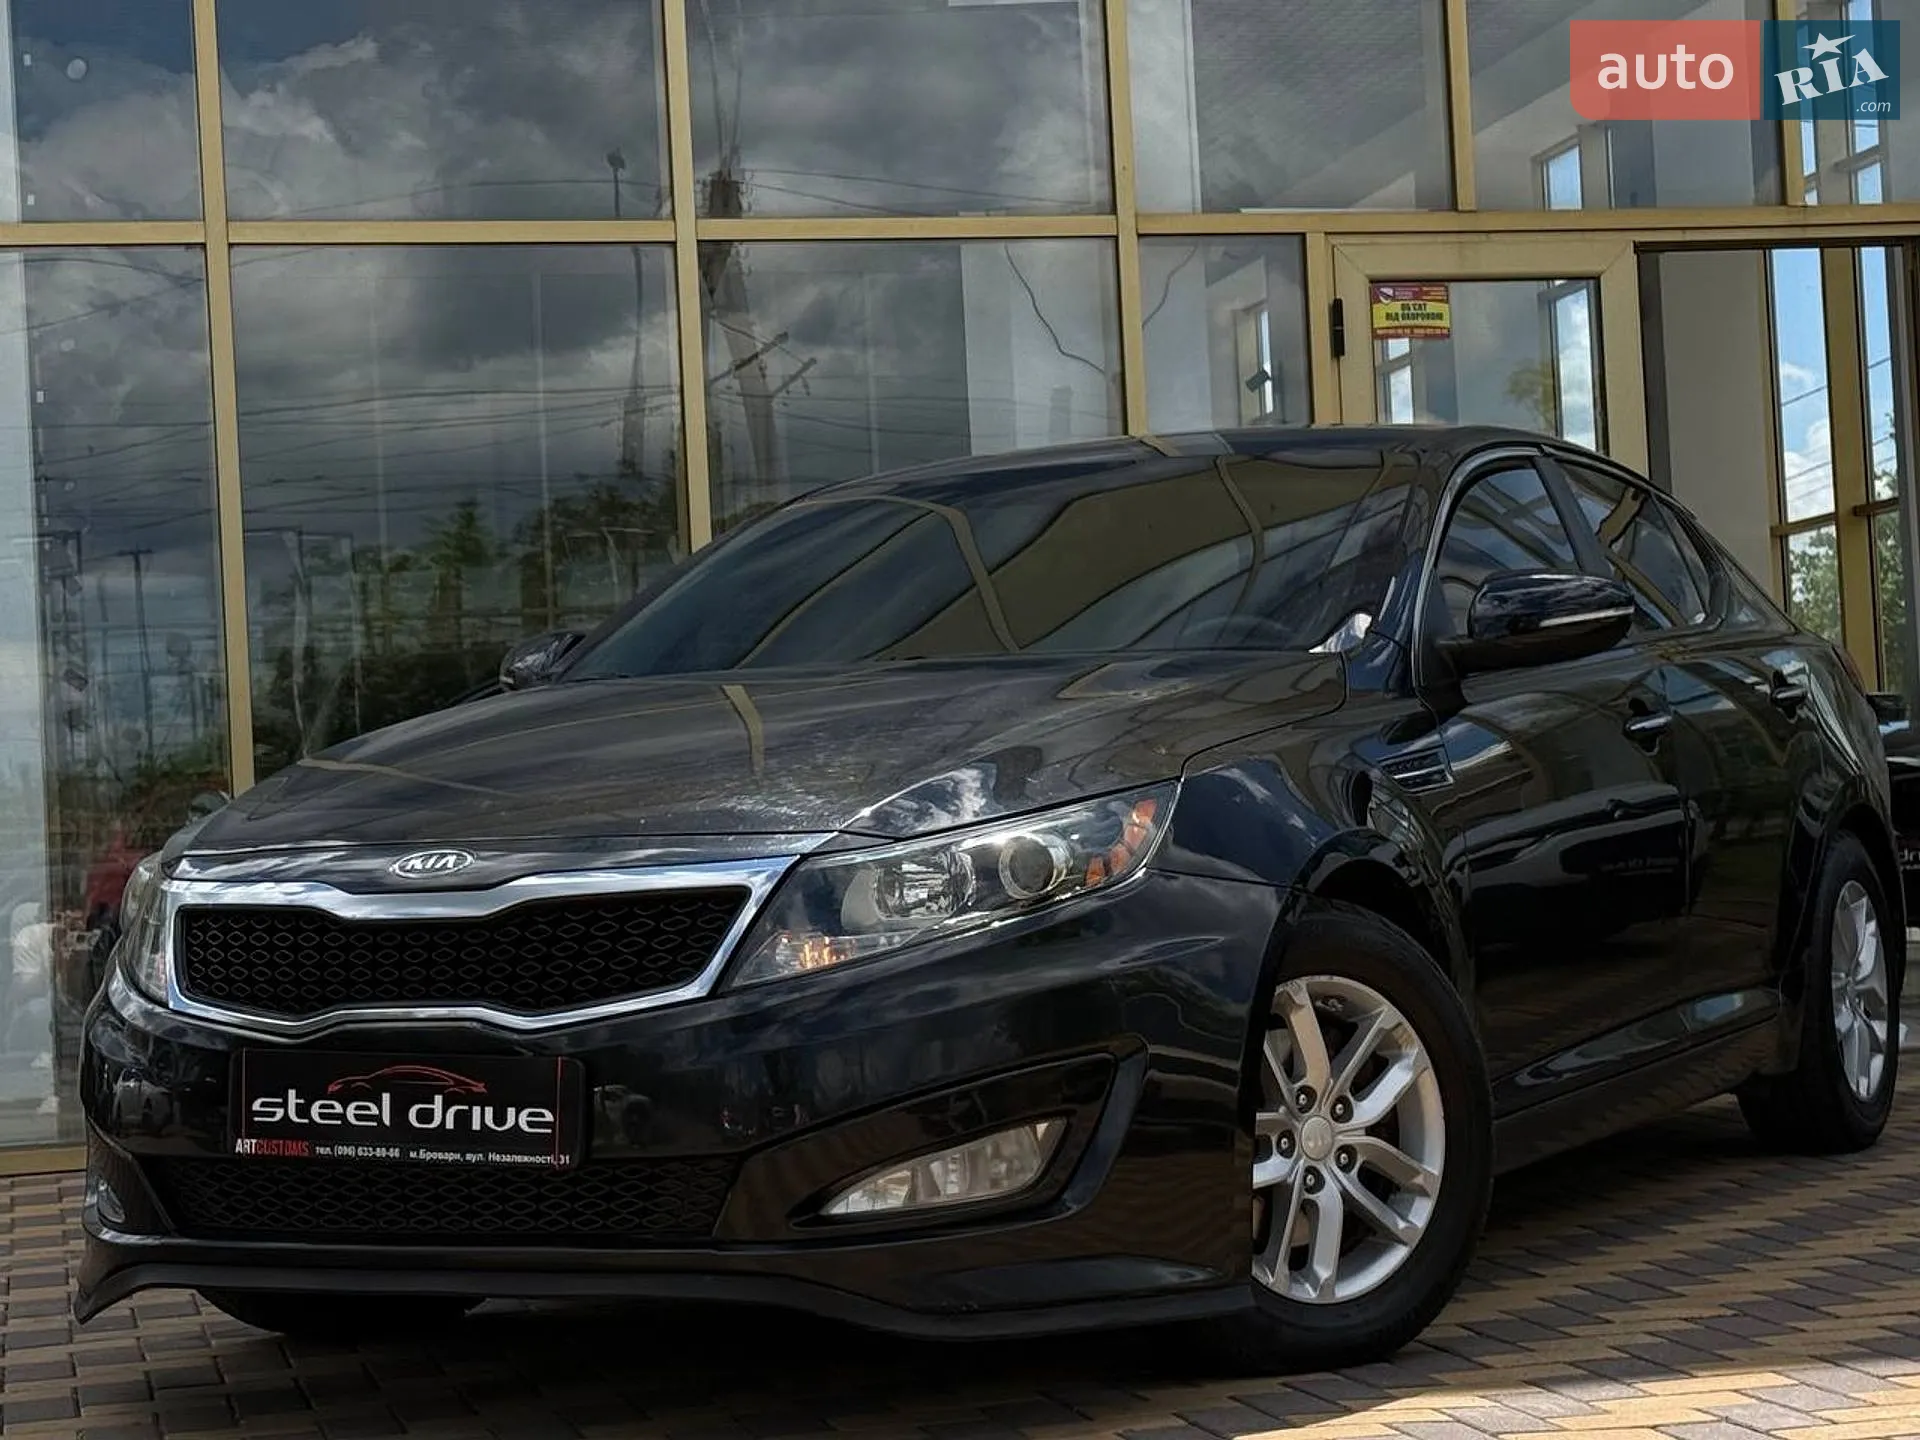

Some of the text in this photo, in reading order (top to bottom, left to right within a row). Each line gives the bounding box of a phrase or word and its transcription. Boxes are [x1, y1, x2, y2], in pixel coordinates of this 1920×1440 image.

[403, 854, 459, 871] KIA
[252, 1088, 555, 1134] steel drive
